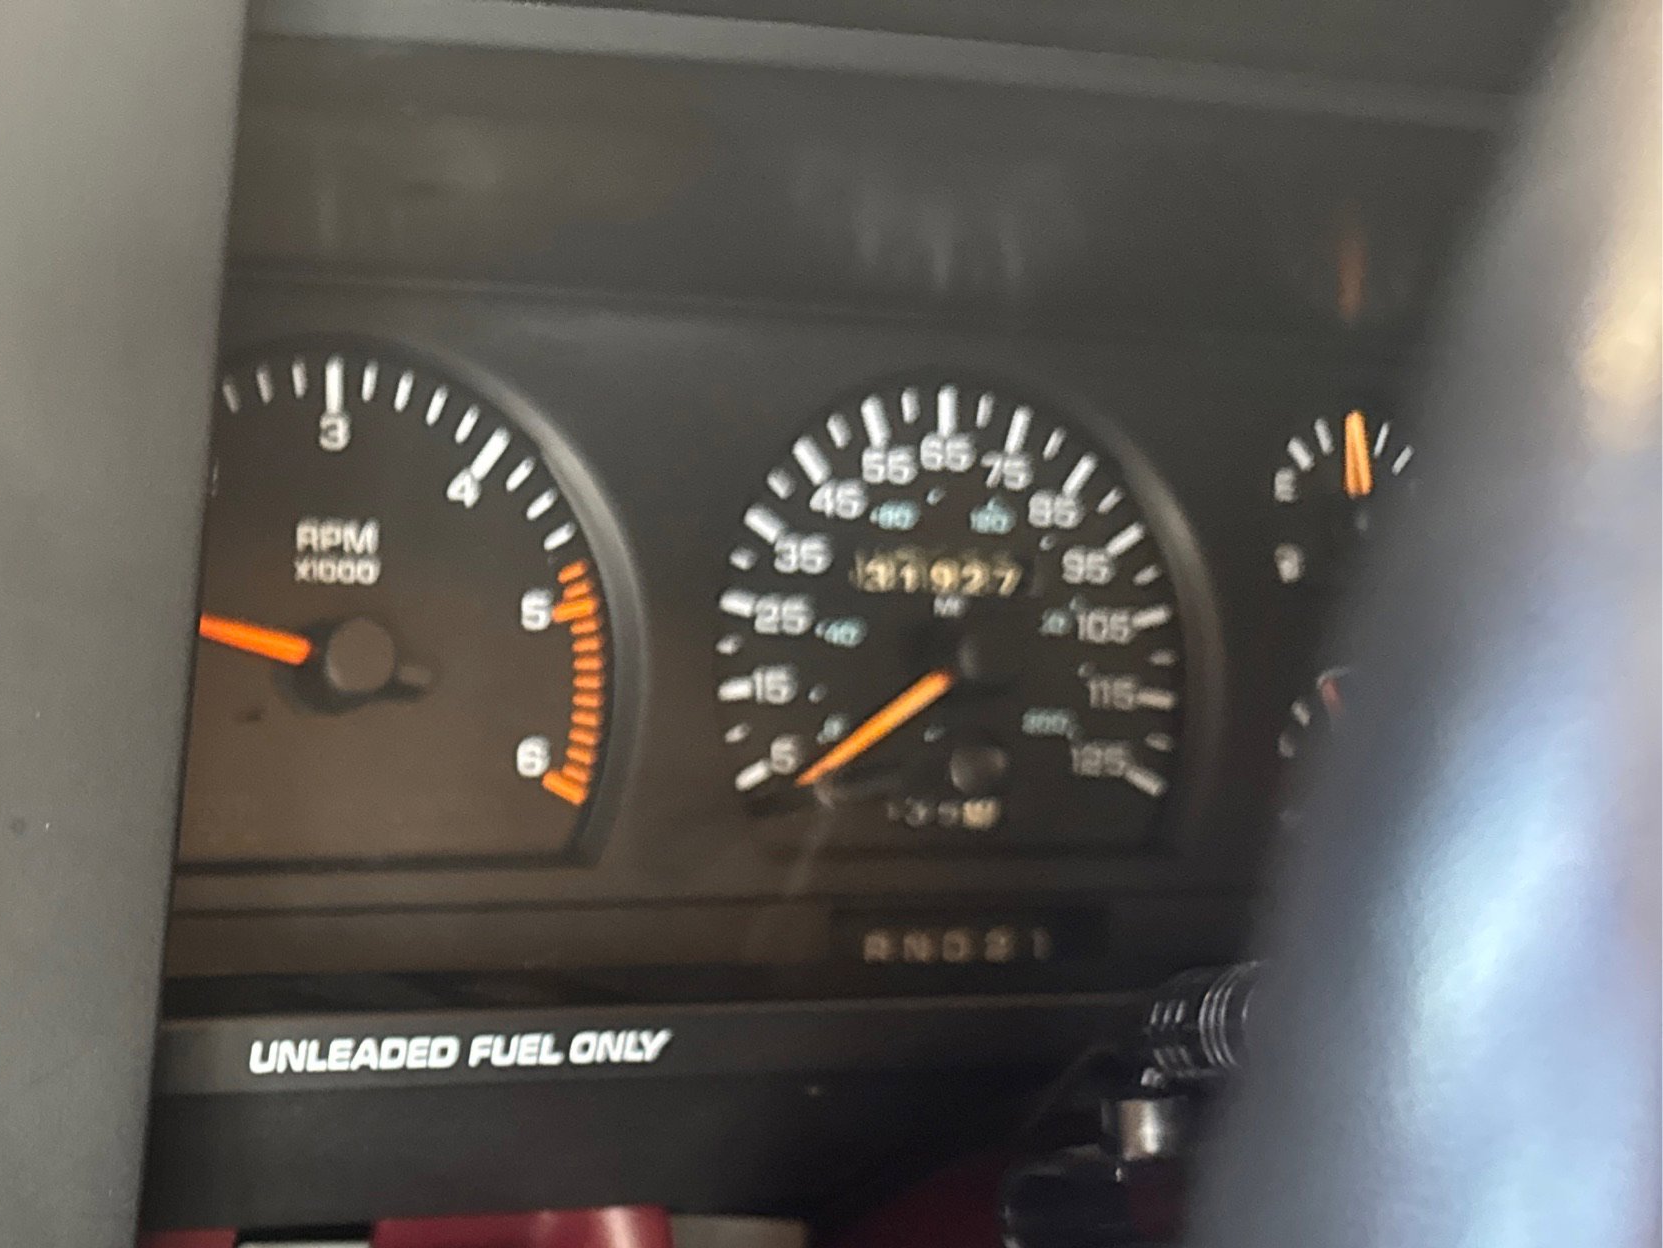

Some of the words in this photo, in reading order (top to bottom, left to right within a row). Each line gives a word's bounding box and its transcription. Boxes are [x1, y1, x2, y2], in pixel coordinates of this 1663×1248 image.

[320, 412, 350, 451] 3
[920, 431, 977, 473] 65
[862, 445, 918, 486] 55
[981, 451, 1034, 490] 75
[447, 468, 481, 507] 4
[810, 478, 869, 520] 45
[296, 519, 380, 554] RPM
[775, 533, 834, 575] 35
[520, 587, 554, 632] 5
[754, 594, 815, 636] 25
[1077, 608, 1134, 644] 105
[753, 664, 798, 705] 15
[249, 1036, 460, 1075] UNLEADED
[467, 1032, 565, 1069] FUEL
[569, 1028, 674, 1065] ONLY
